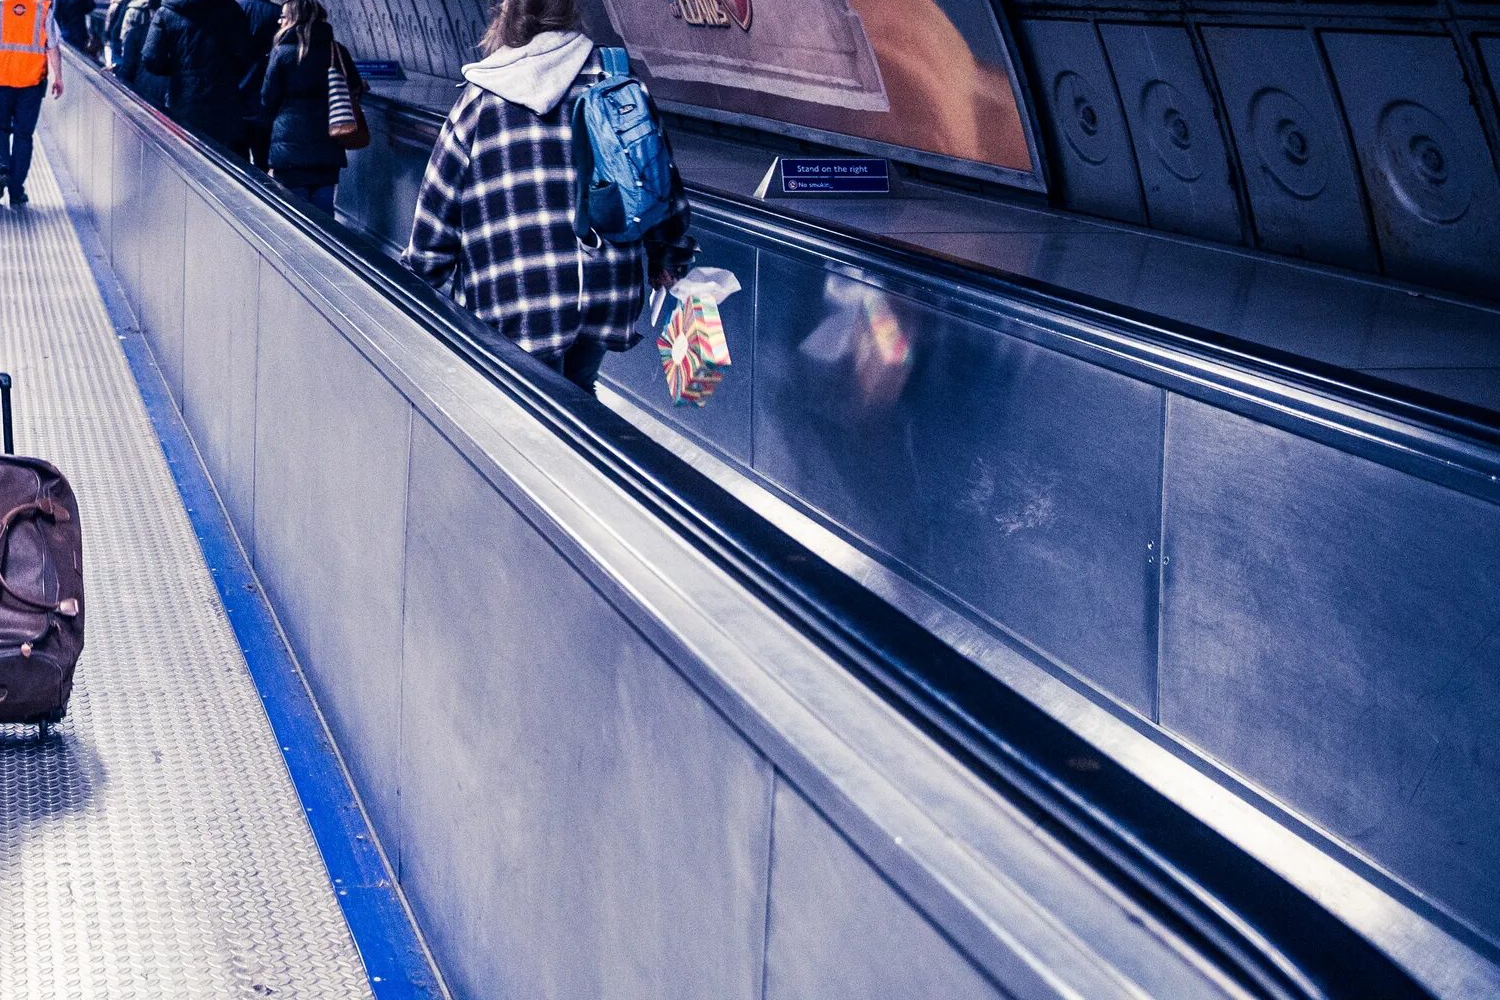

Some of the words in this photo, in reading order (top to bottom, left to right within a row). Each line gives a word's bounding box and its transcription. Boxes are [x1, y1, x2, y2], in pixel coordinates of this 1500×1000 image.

[797, 165, 820, 173] Stand
[833, 165, 848, 173] the
[849, 165, 869, 175] right
